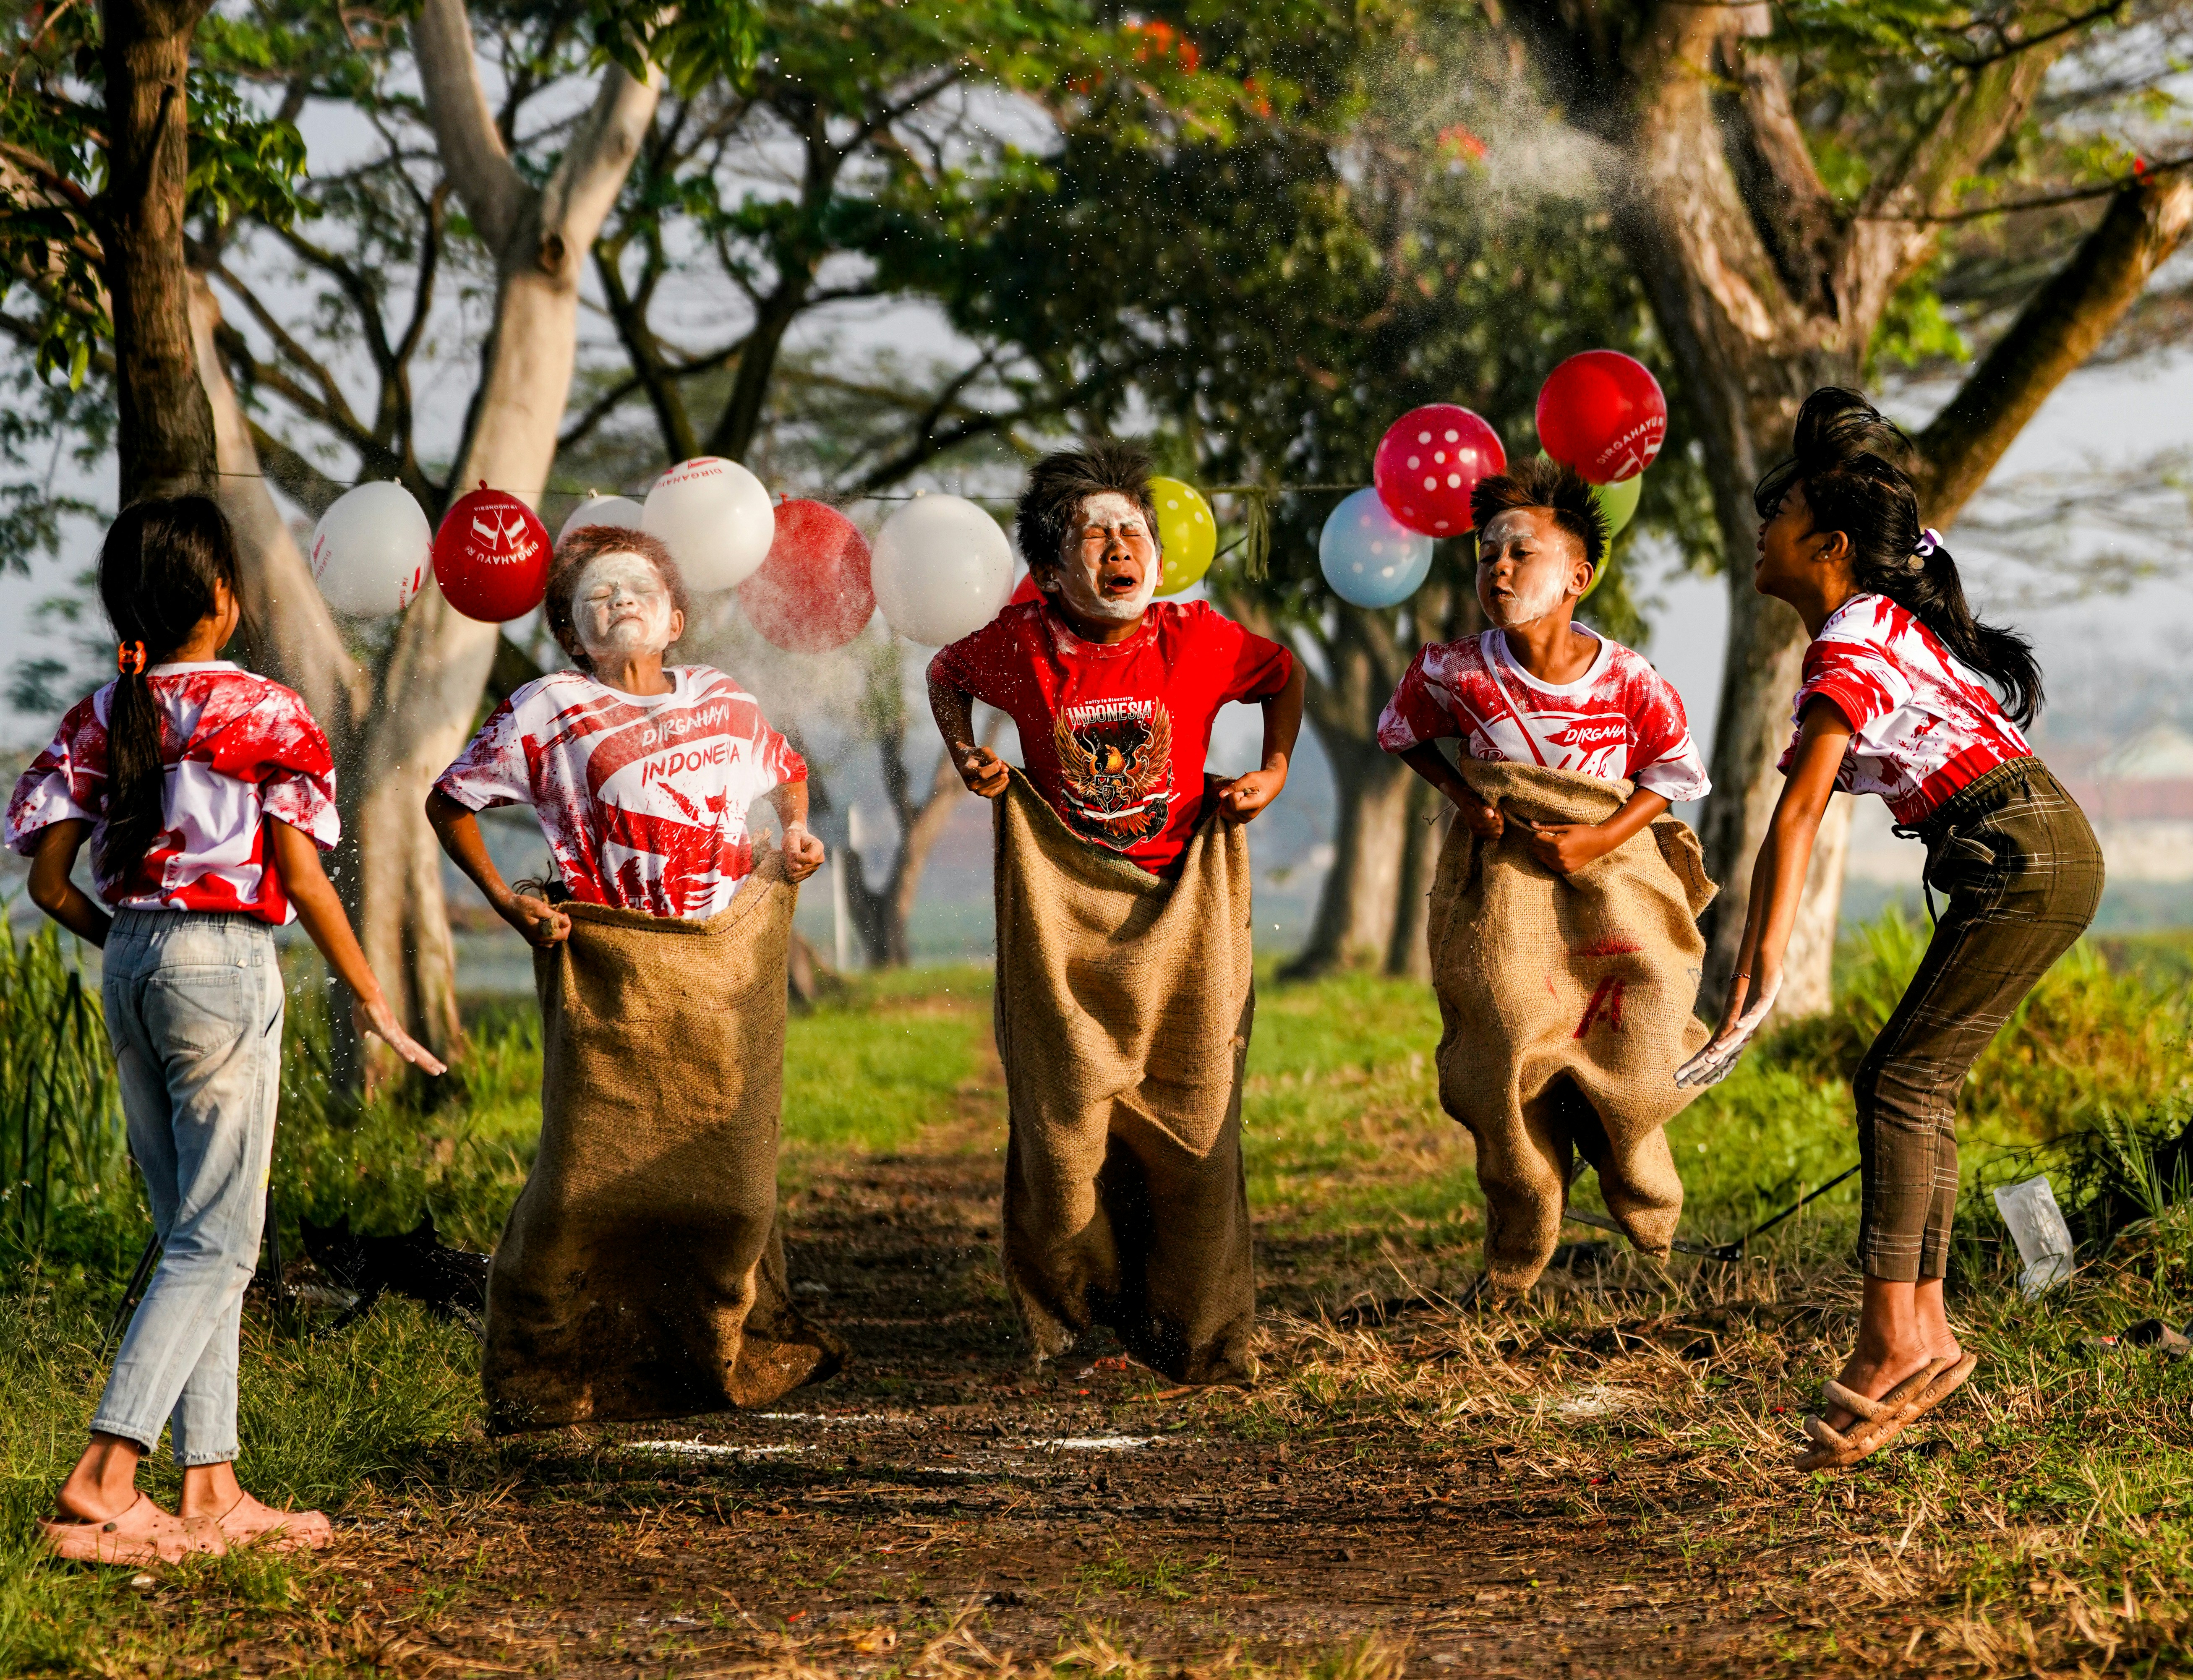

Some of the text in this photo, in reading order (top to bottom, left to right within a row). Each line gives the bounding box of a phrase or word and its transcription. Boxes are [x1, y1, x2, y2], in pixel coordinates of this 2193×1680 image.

[1596, 415, 1657, 464] DIRGAHAYU
[476, 540, 539, 565] DIRGAHAYU
[642, 702, 730, 747] DIRGAHAYU
[1067, 700, 1152, 725] INDONESIA
[1564, 724, 1626, 743] DIRGAHA
